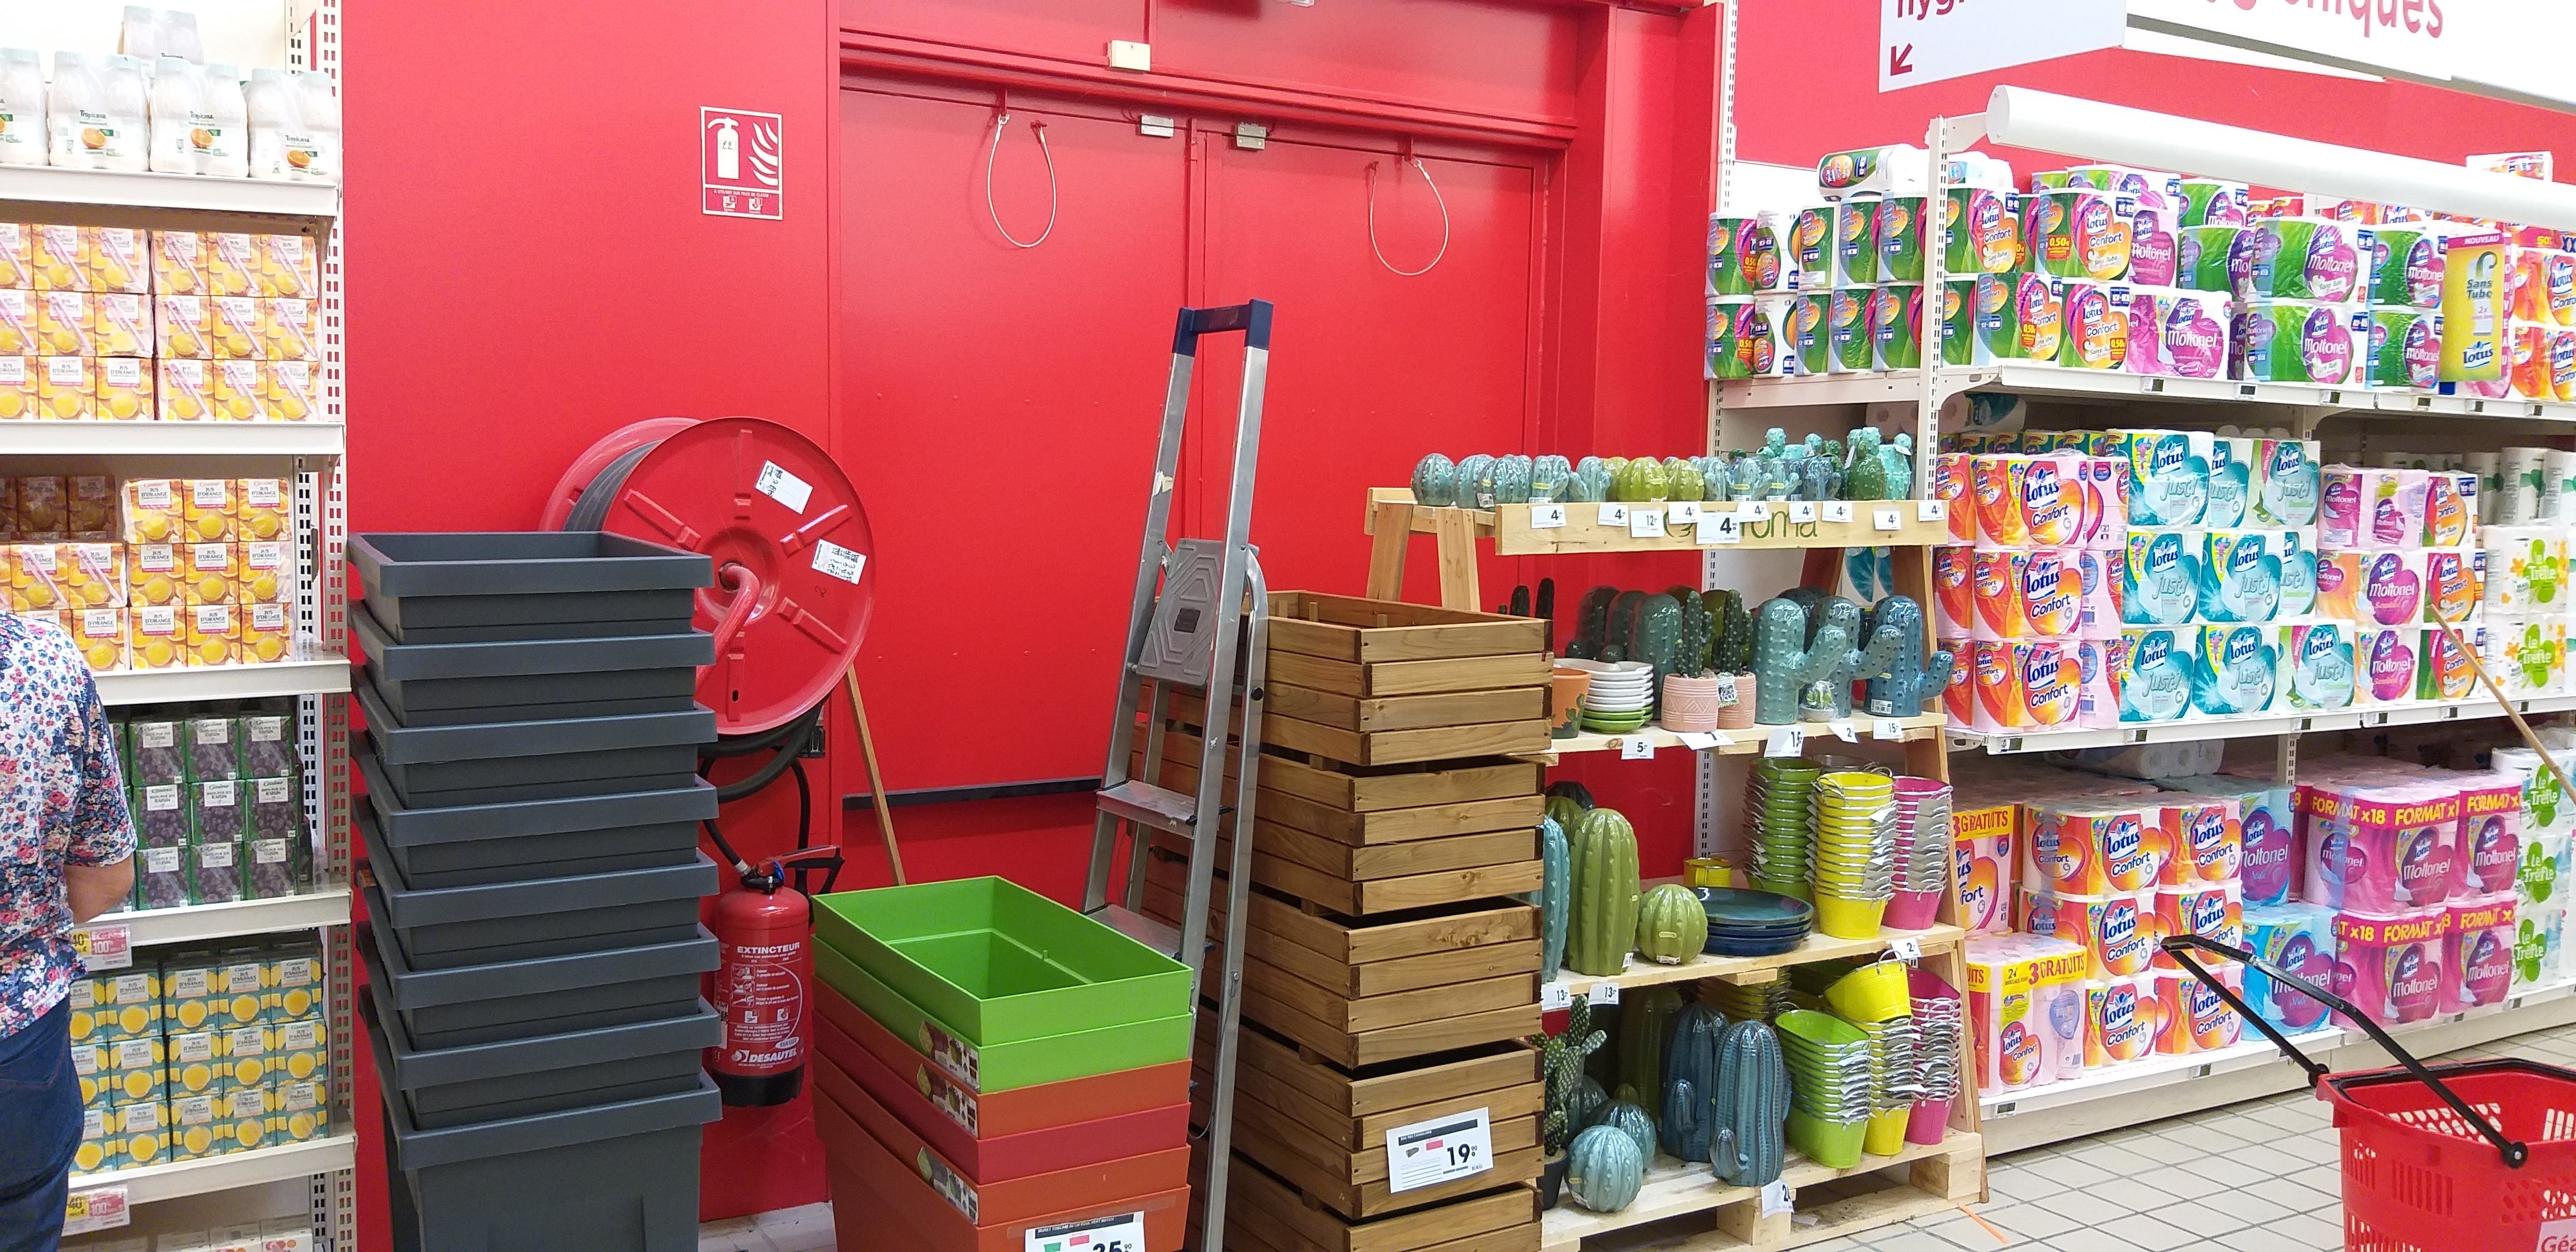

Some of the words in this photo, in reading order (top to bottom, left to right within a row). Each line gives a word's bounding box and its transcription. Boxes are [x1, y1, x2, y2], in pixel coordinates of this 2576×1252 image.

[79, 110, 106, 119] Tropicana
[1982, 212, 2000, 225] lotus
[2087, 217, 2108, 229] lotus
[1985, 229, 2011, 243] Confort
[2090, 233, 2123, 247] Confort
[2464, 235, 2500, 245] NOUVEAU
[2132, 243, 2171, 261] Moltonel
[2308, 254, 2353, 273] Moltonel
[2466, 279, 2493, 289] Sans
[2552, 272, 2573, 288] lotus
[2466, 290, 2492, 299] Tube
[2083, 307, 2104, 320] lotus
[2176, 314, 2195, 324] lotus
[2086, 322, 2118, 336] Confort
[2167, 329, 2217, 348] Moltonel
[2304, 338, 2347, 355] Moltonel
[2463, 347, 2494, 364] lotus
[2554, 348, 2575, 364] lotus
[2156, 450, 2184, 470] lotus
[2276, 456, 2300, 472] lotus
[1937, 482, 1957, 492] Confort
[2026, 481, 2059, 502] lotus
[1551, 509, 1559, 520] 4
[1614, 509, 1622, 520] 4
[1685, 506, 1692, 516] 4
[1754, 505, 1761, 515] 4
[1802, 506, 1810, 516] 4
[1836, 506, 1844, 516] 4
[1931, 505, 1938, 515] 4
[2033, 505, 2068, 528] Confort
[1646, 515, 1654, 526] 12
[1720, 518, 1731, 534] 4
[1888, 514, 1895, 524] 4
[1939, 561, 1952, 571] lotus
[2152, 550, 2179, 568] lotus
[2234, 549, 2259, 568] lotus
[1939, 571, 1958, 580] Confort
[1974, 569, 1990, 579] lotus
[1976, 580, 1997, 589] Confort
[2026, 571, 2060, 594] lotus
[2369, 582, 2416, 597] Moltonel
[2032, 595, 2071, 618] Confort
[2231, 642, 2256, 660] lotus
[2309, 639, 2334, 656] lotus
[1977, 656, 1993, 666] lotus
[2142, 647, 2167, 666] lotus
[1978, 668, 1999, 676] Confort
[2027, 659, 2059, 684] lotus
[2372, 658, 2411, 675] Moltonel
[2030, 682, 2068, 707] Confort
[1847, 728, 1852, 737] 2
[1888, 723, 1896, 733] 15
[1791, 731, 1801, 748] 15
[1637, 743, 1644, 753] 5
[2467, 793, 2510, 813] FORMAT
[1961, 810, 2009, 833] GRATUITS
[2361, 808, 2386, 825] x18
[2395, 803, 2447, 826] FORMAT
[2194, 822, 2224, 845] lotus
[2246, 827, 2265, 843] lotus
[2035, 837, 2061, 848] lotus
[2107, 830, 2141, 855] lotus
[2038, 855, 2069, 864] Confort
[2198, 842, 2233, 866] Confort
[2240, 843, 2289, 867] Moltonel
[2476, 847, 2516, 866] Moltonel
[2112, 852, 2151, 876] Confort
[2404, 859, 2451, 881] Moltonel
[2032, 920, 2056, 931] lotus
[2195, 905, 2225, 930] lotus
[2104, 917, 2136, 940] lotus
[2350, 926, 2375, 941] x18
[2383, 921, 2434, 943] FORMAT
[737, 942, 801, 955] EXTINCTEUR
[1907, 942, 1914, 952] 2
[2108, 937, 2145, 961] Confort
[2286, 953, 2306, 968] lotus
[2028, 962, 2039, 985] 3
[2040, 954, 2085, 978] GRATUITS
[2468, 960, 2510, 982] Moltonel
[1605, 987, 1613, 998] 13
[2393, 974, 2437, 998] Moltonel
[1556, 989, 1565, 1002] 13
[2105, 1001, 2135, 1025] lotus
[2197, 1011, 2232, 1035] Confort
[2108, 1021, 2145, 1046] Confort
[2003, 1038, 2022, 1052] lotus
[2013, 1043, 2038, 1061] Confort
[749, 1047, 798, 1063] DESAUTEL
[1447, 1144, 1470, 1166] 19
